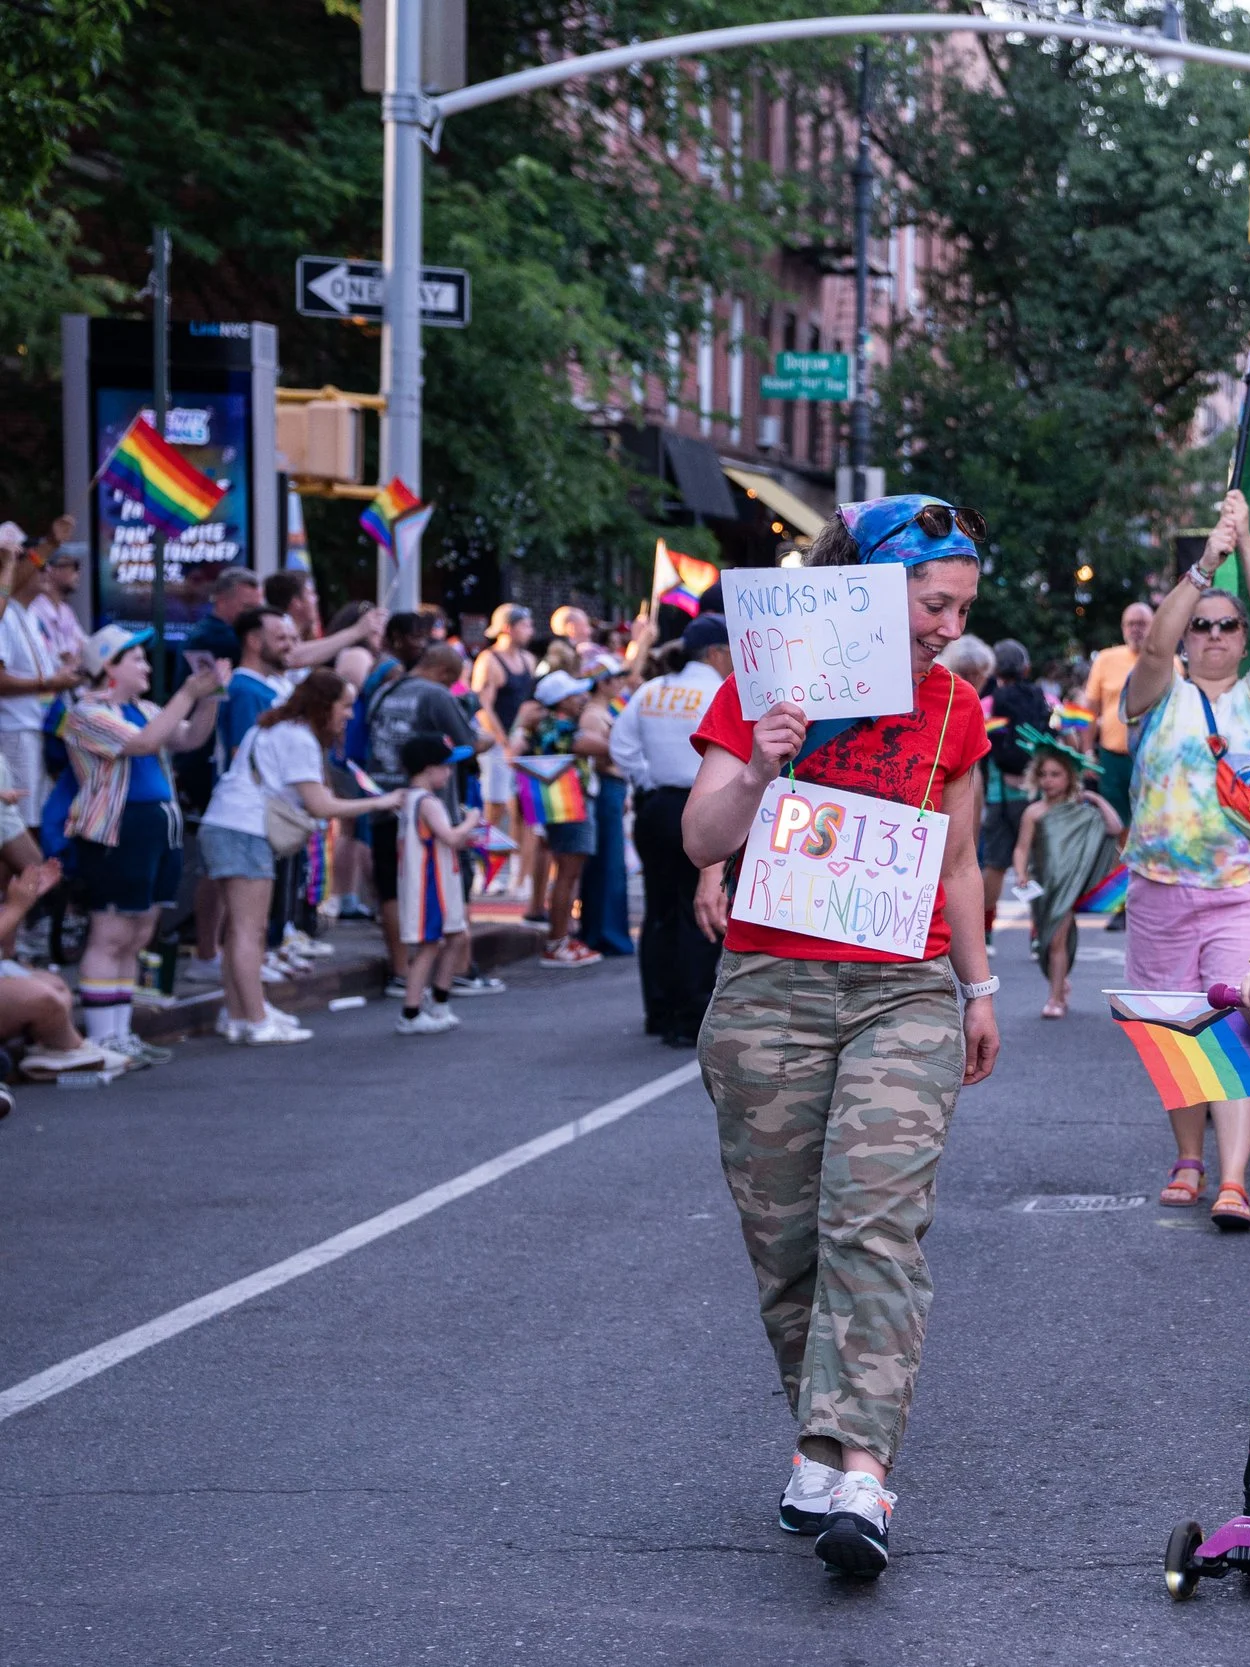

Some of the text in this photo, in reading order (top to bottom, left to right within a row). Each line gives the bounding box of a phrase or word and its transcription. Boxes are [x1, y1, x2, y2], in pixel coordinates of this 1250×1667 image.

[330, 278, 379, 302] ONE
[735, 576, 870, 621] KNICKS IN 5
[766, 618, 871, 673] Pride
[869, 626, 886, 645] IN
[643, 686, 703, 711] NYPD
[749, 674, 872, 711] Genocide
[843, 814, 928, 879] 139
[748, 858, 925, 944] RAINBOW
[912, 882, 935, 950] FAMILIES
